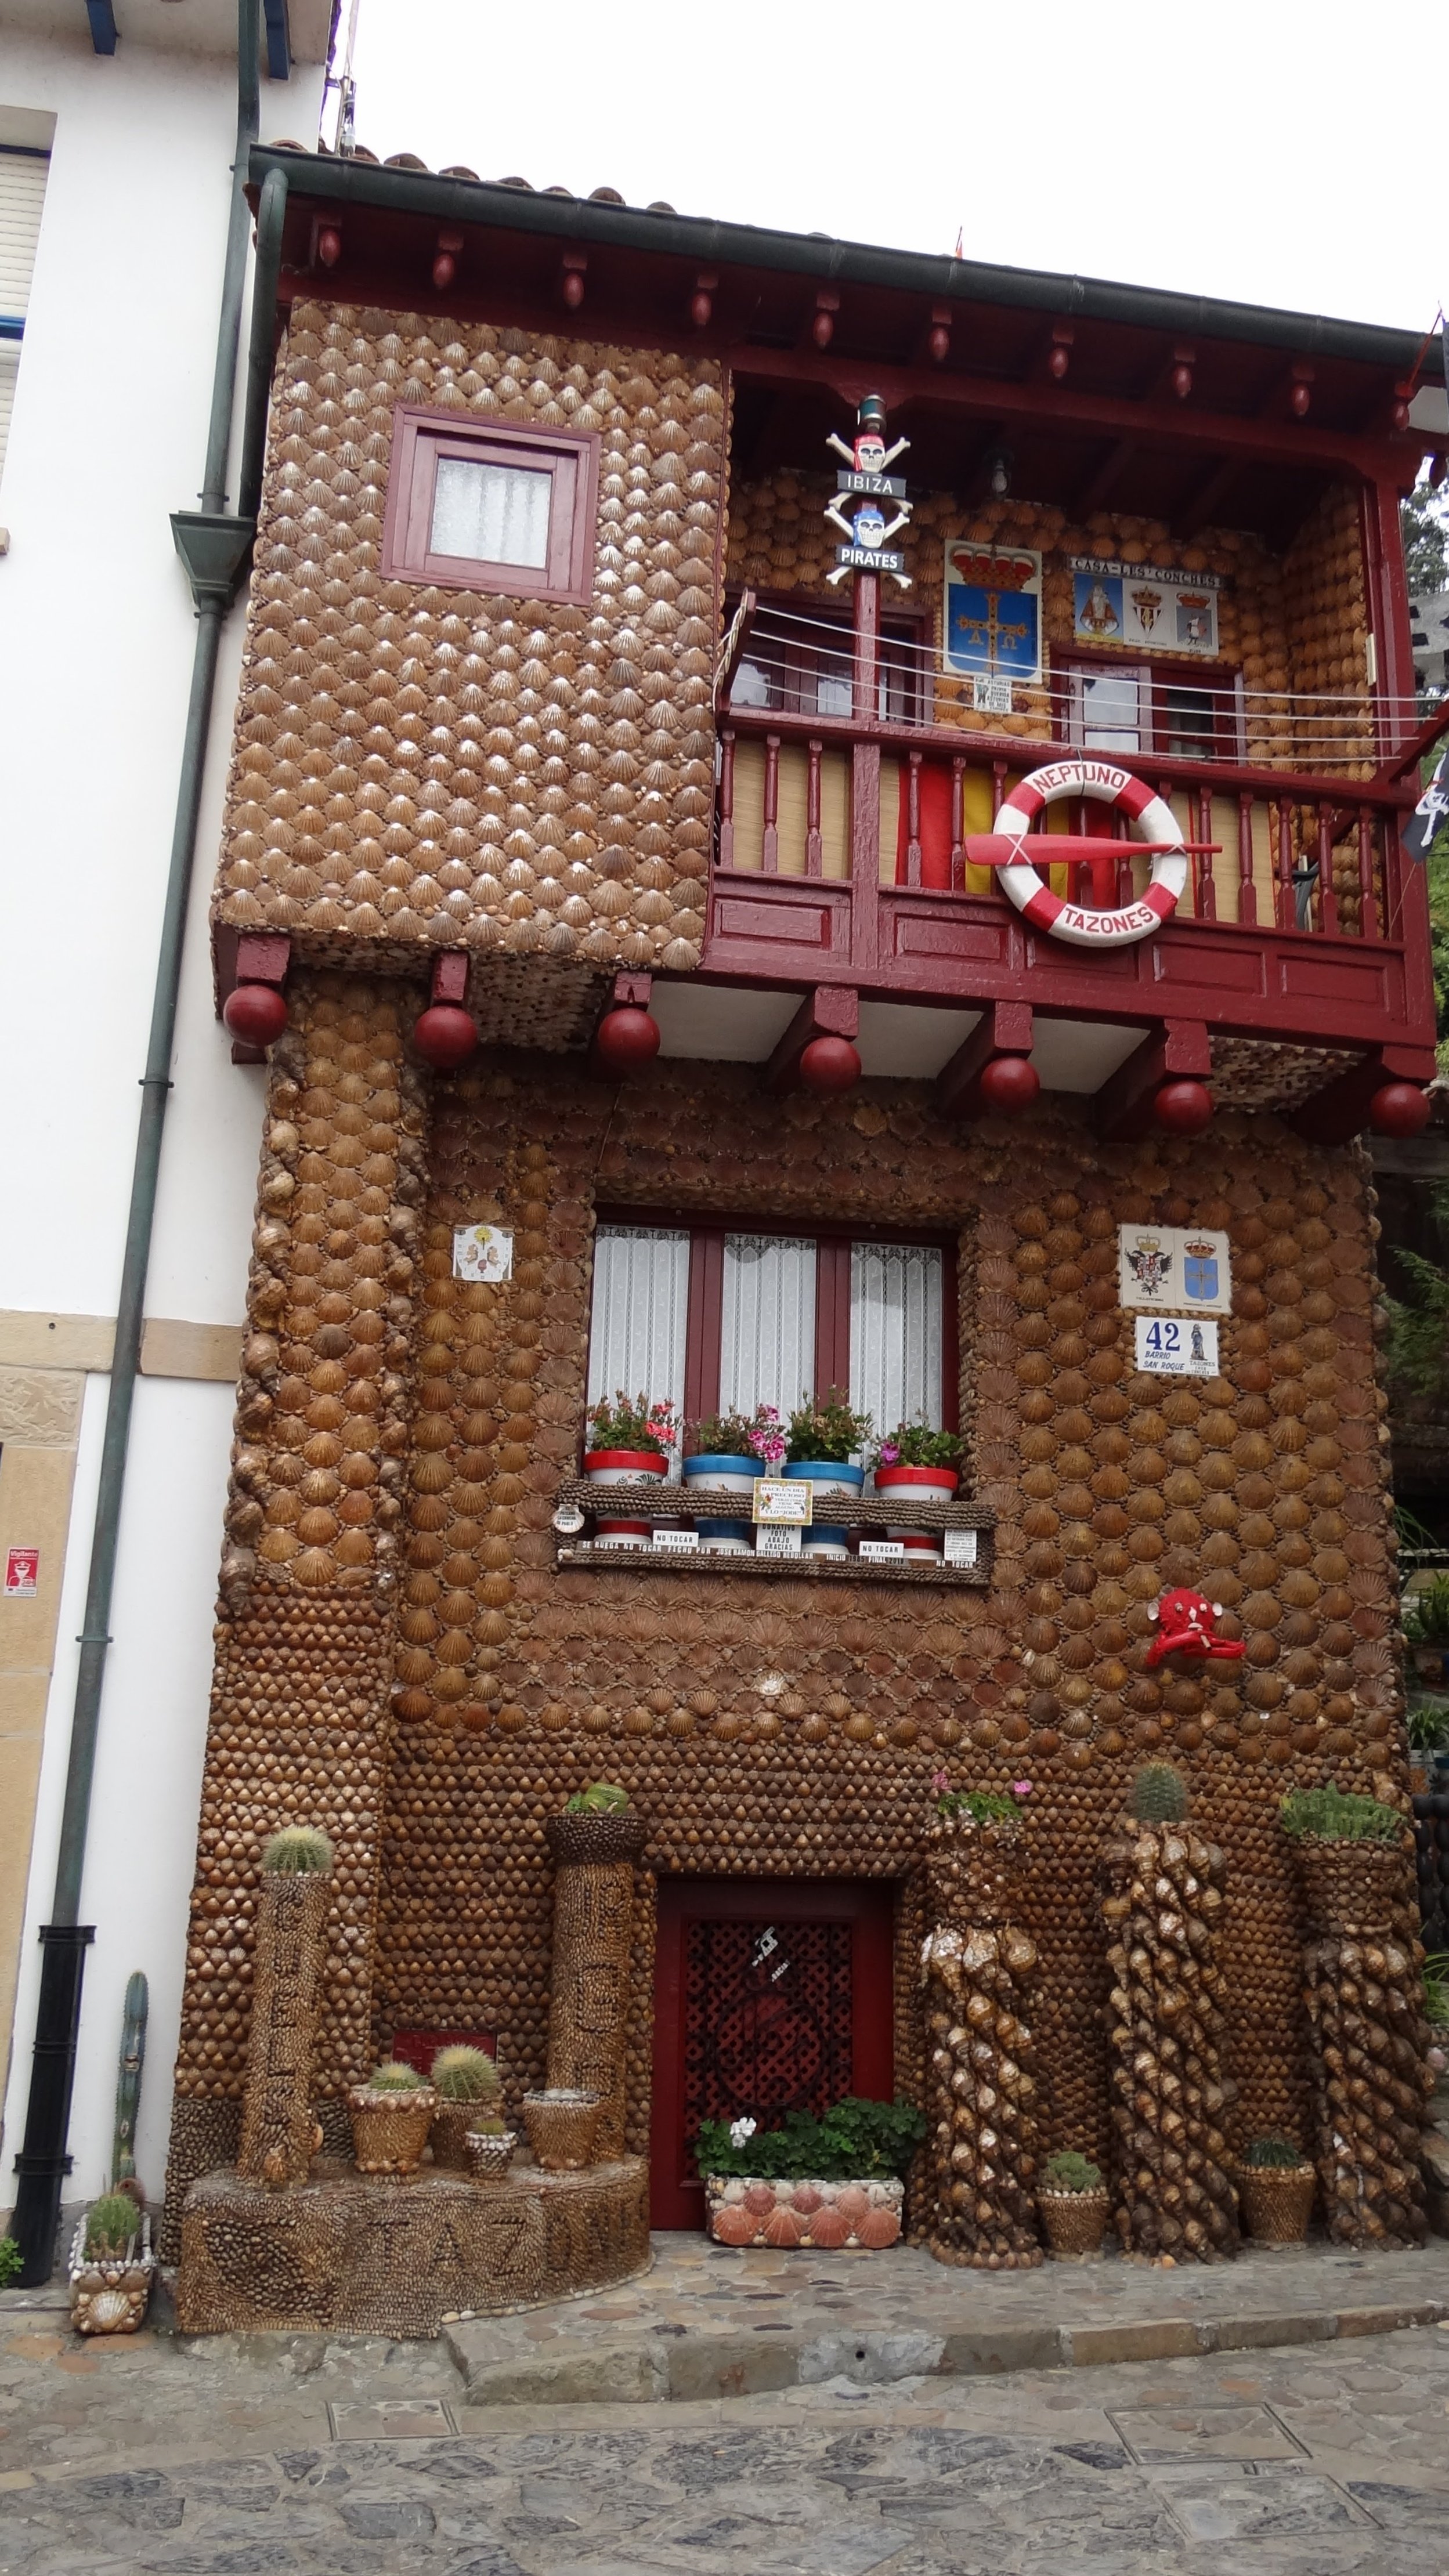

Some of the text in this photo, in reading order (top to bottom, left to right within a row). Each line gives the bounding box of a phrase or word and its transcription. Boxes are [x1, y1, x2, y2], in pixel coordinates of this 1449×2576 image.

[847, 474, 892, 494] IBIZA
[841, 548, 898, 569] PIRATES
[1155, 571, 1216, 586] CONCHES
[1032, 764, 1126, 793] NEPTUNO
[1065, 906, 1154, 935] TAZONES
[1146, 1322, 1180, 1352] 42
[1145, 1351, 1171, 1359] BARRIO
[1143, 1361, 1185, 1371] SAN ROQUE
[595, 1542, 619, 1550] RUEGA
[639, 1544, 662, 1553] TOCAR
[667, 1546, 692, 1554] FECHU
[868, 1555, 887, 1564] FINAL
